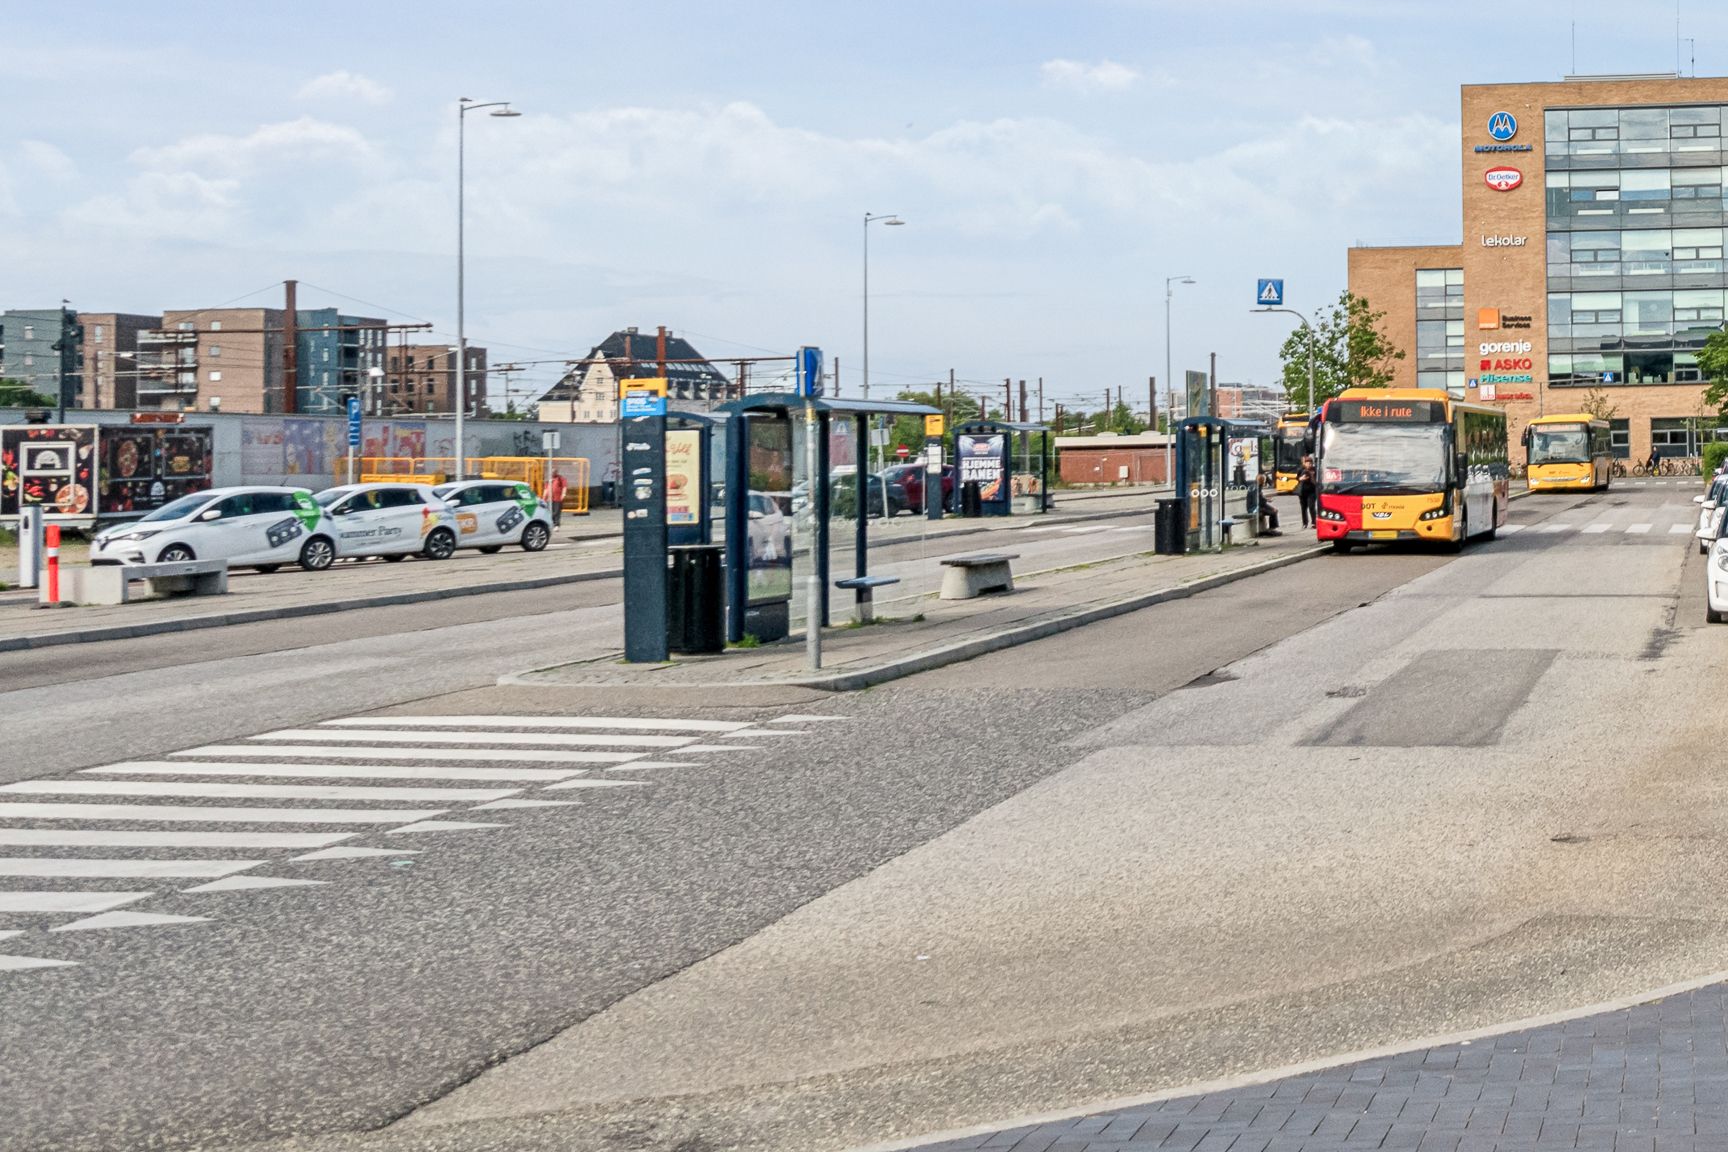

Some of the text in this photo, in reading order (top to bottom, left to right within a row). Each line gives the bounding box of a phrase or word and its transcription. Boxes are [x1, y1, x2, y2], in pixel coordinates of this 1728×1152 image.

[1481, 234, 1527, 246] lekolar
[1479, 338, 1532, 356] gorenje
[1494, 358, 1532, 370] ASKO
[1360, 406, 1381, 417] Ikke
[1391, 407, 1412, 417] rute
[962, 459, 1001, 469] HJEMME
[962, 469, 1001, 480] BANEN
